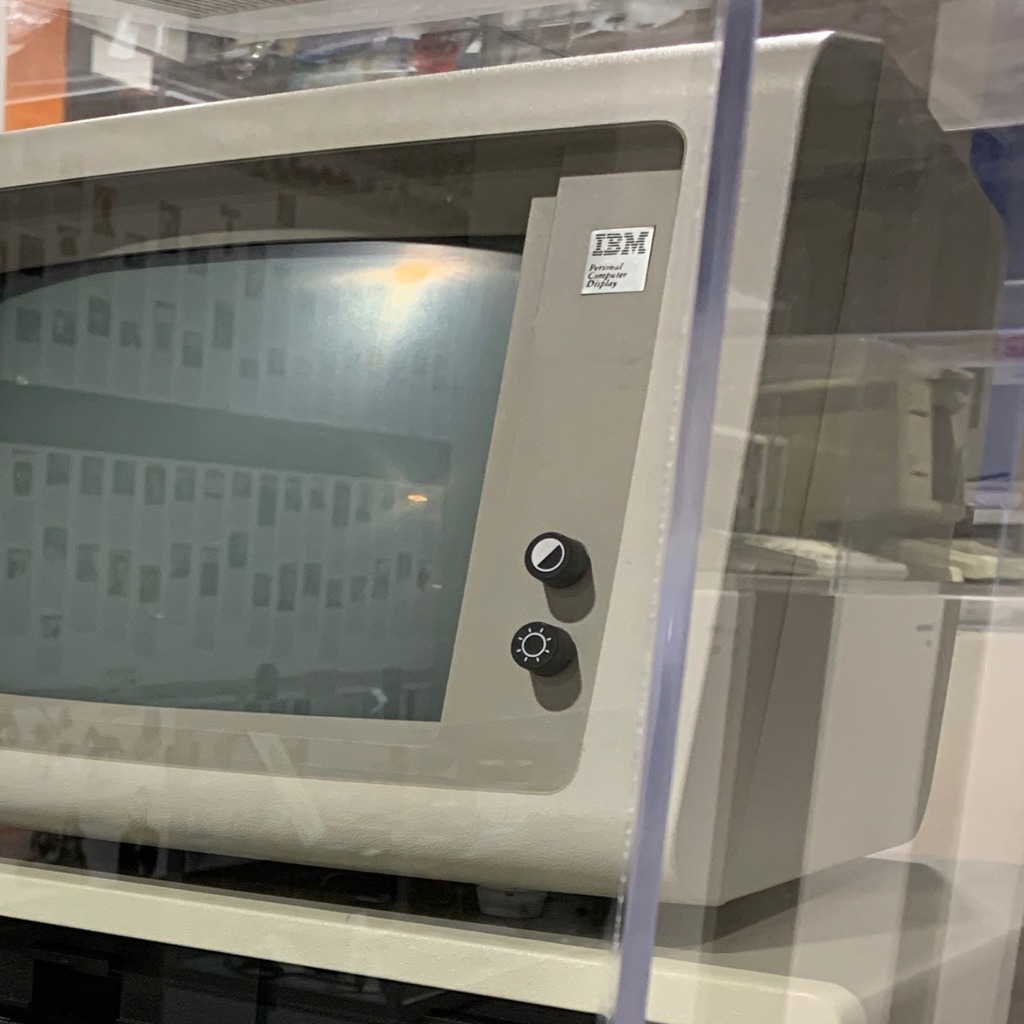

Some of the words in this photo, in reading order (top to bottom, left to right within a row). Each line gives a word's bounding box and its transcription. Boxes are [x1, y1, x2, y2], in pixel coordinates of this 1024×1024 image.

[592, 231, 649, 256] IBM
[589, 262, 624, 272] Personal
[587, 272, 627, 281] Computer
[586, 280, 618, 289] Display
